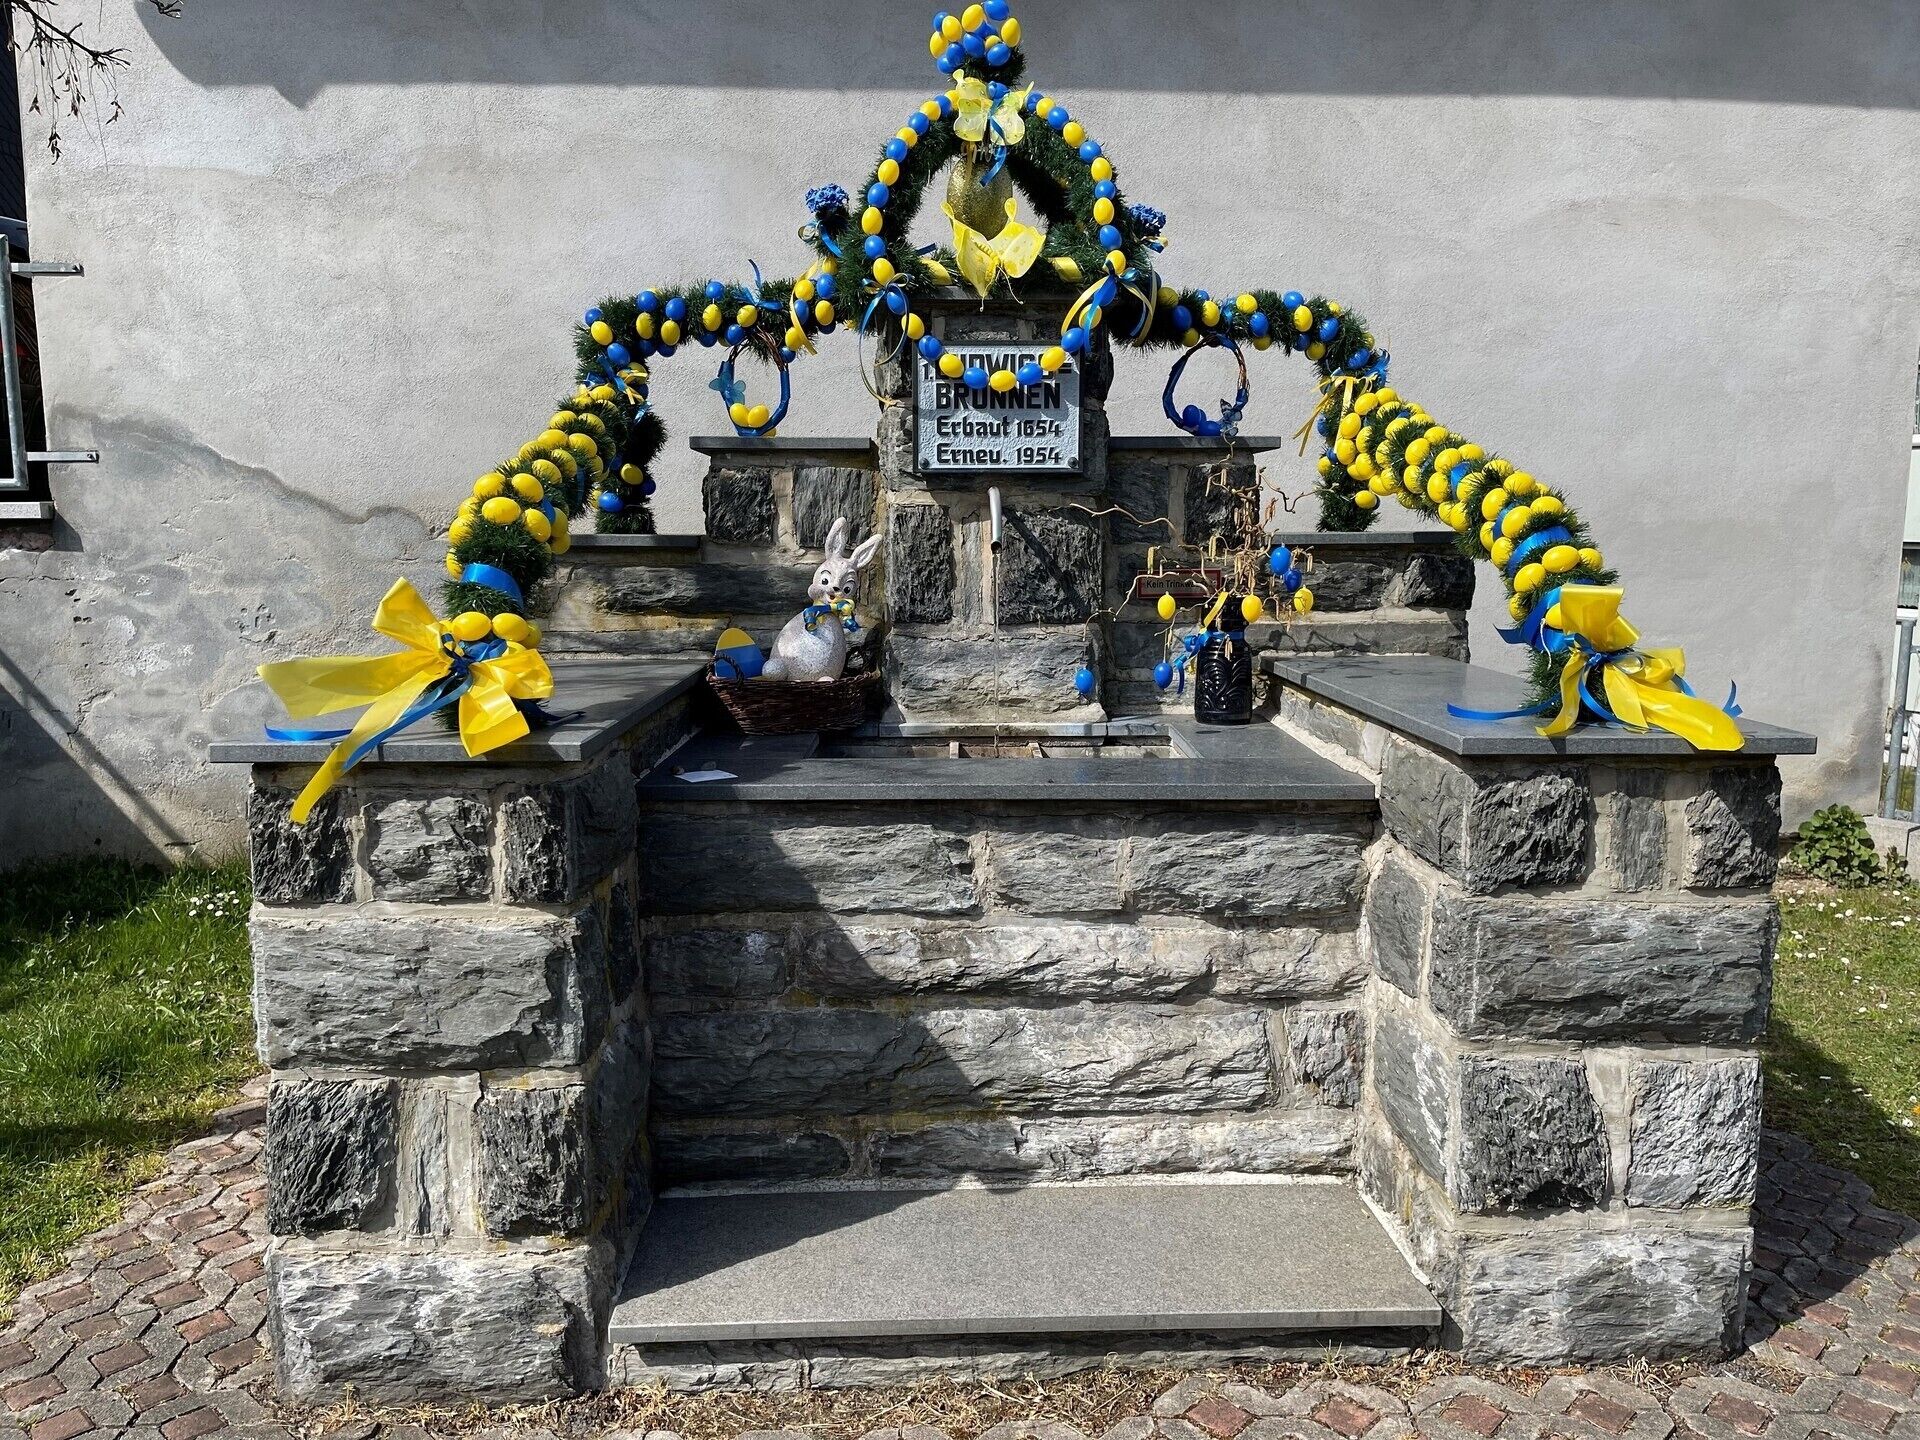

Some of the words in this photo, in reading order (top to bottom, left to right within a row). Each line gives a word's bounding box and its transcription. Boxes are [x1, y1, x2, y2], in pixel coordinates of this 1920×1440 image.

[935, 382, 1061, 409] BRUNNEN
[936, 415, 1010, 438] Erbaut
[1015, 418, 1062, 438] 1654
[936, 442, 1008, 466] Erneu.
[1015, 446, 1062, 466] 1954
[1146, 579, 1164, 589] Kein
